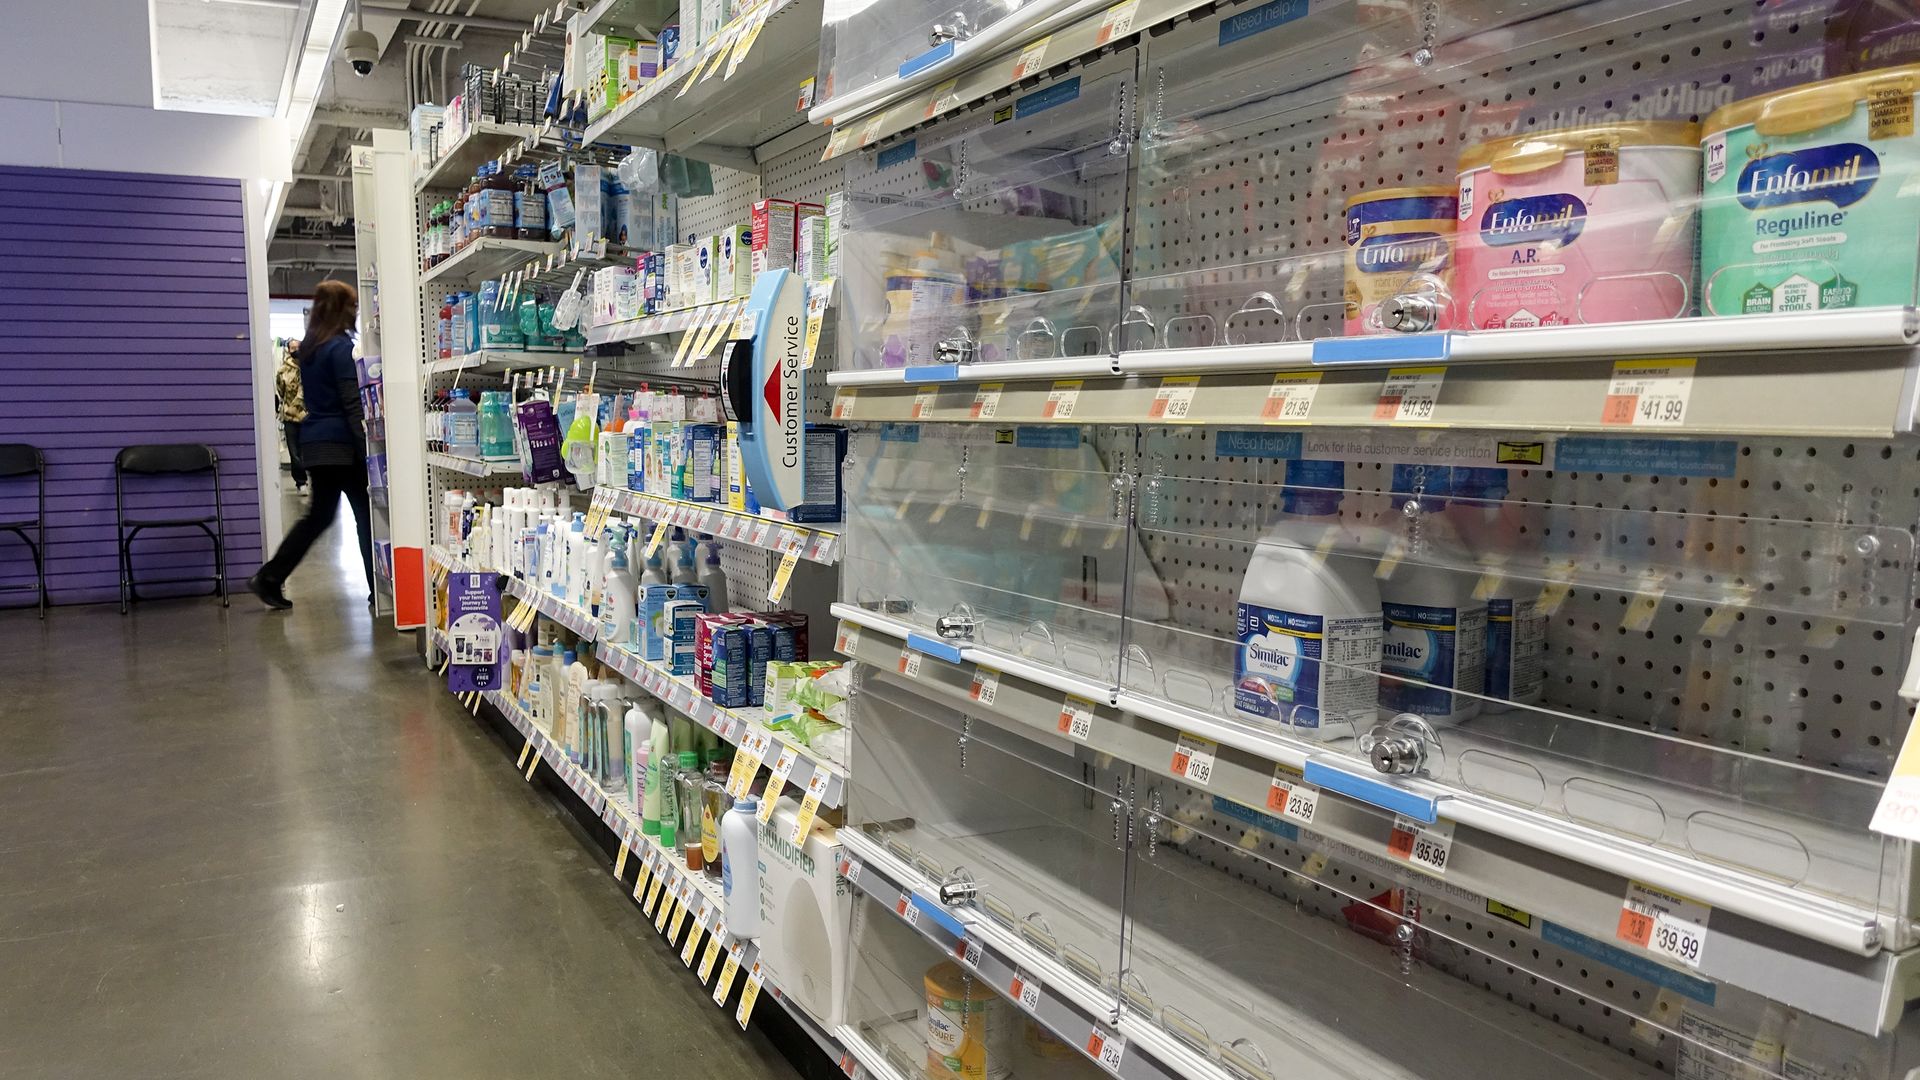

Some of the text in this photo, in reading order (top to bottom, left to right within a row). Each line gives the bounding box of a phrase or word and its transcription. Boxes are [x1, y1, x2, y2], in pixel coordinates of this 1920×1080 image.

[1231, 11, 1262, 34] Need
[1749, 154, 1861, 199] Enfamil
[1489, 204, 1574, 236] Enfamil
[1756, 211, 1844, 237] Reguline
[1362, 241, 1438, 265] Enfamil
[1746, 297, 1771, 306] BRAIN
[1778, 303, 1812, 312] STOOLS
[1784, 295, 1807, 304] SOFT
[783, 315, 799, 468] Customer Service
[1284, 400, 1310, 416] $21.99
[1402, 399, 1433, 417] $41.99
[1640, 400, 1683, 420] $41.99
[1228, 434, 1292, 451] Need help?
[1307, 441, 1491, 458] Look for the customer service button
[1267, 613, 1274, 622] NO
[1287, 618, 1296, 626] NO
[1390, 609, 1400, 617] NO
[1417, 612, 1427, 620] NO
[1249, 643, 1290, 667] Similac
[1383, 641, 1422, 660] milac
[1189, 761, 1210, 781] $10.99
[1289, 796, 1314, 819] $23.99
[762, 826, 816, 878] HUMIDIFIER
[1415, 841, 1446, 867] $35.99
[1303, 829, 1482, 904] Look for the customer service button
[1656, 927, 1699, 960] $39.99
